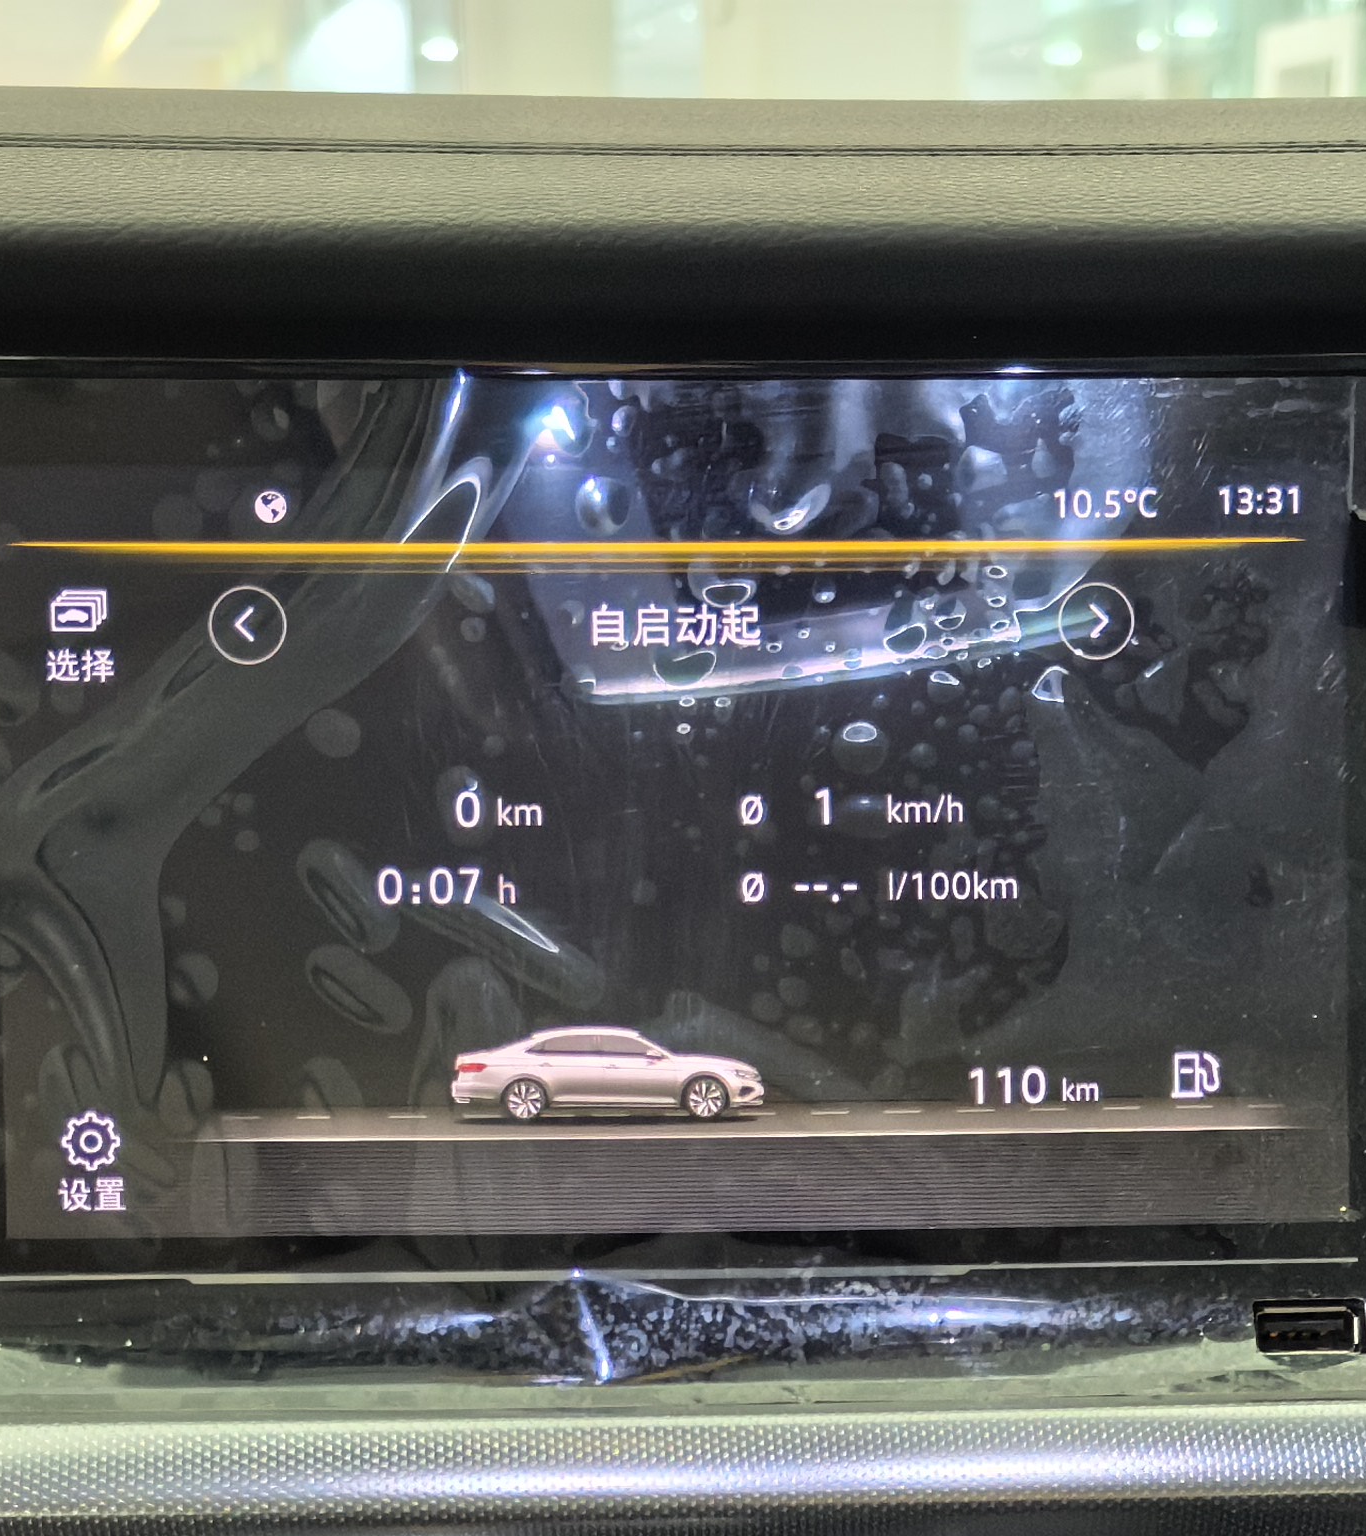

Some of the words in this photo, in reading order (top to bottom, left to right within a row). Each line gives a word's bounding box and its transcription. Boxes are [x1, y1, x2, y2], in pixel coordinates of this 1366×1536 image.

[1054, 486, 1158, 520] 10.5°C
[1218, 484, 1302, 516] 13:31
[589, 603, 762, 648] 自启动起
[45, 648, 116, 684] 选择
[455, 791, 481, 829] 0
[497, 797, 545, 827] km
[814, 787, 833, 826] 1
[885, 793, 965, 825] km/h
[377, 867, 481, 906] 0:07
[497, 874, 517, 905] h
[887, 869, 1019, 902] l/100km
[968, 1066, 1048, 1106] 110
[1062, 1076, 1100, 1103] km
[58, 1176, 128, 1213] 设置
